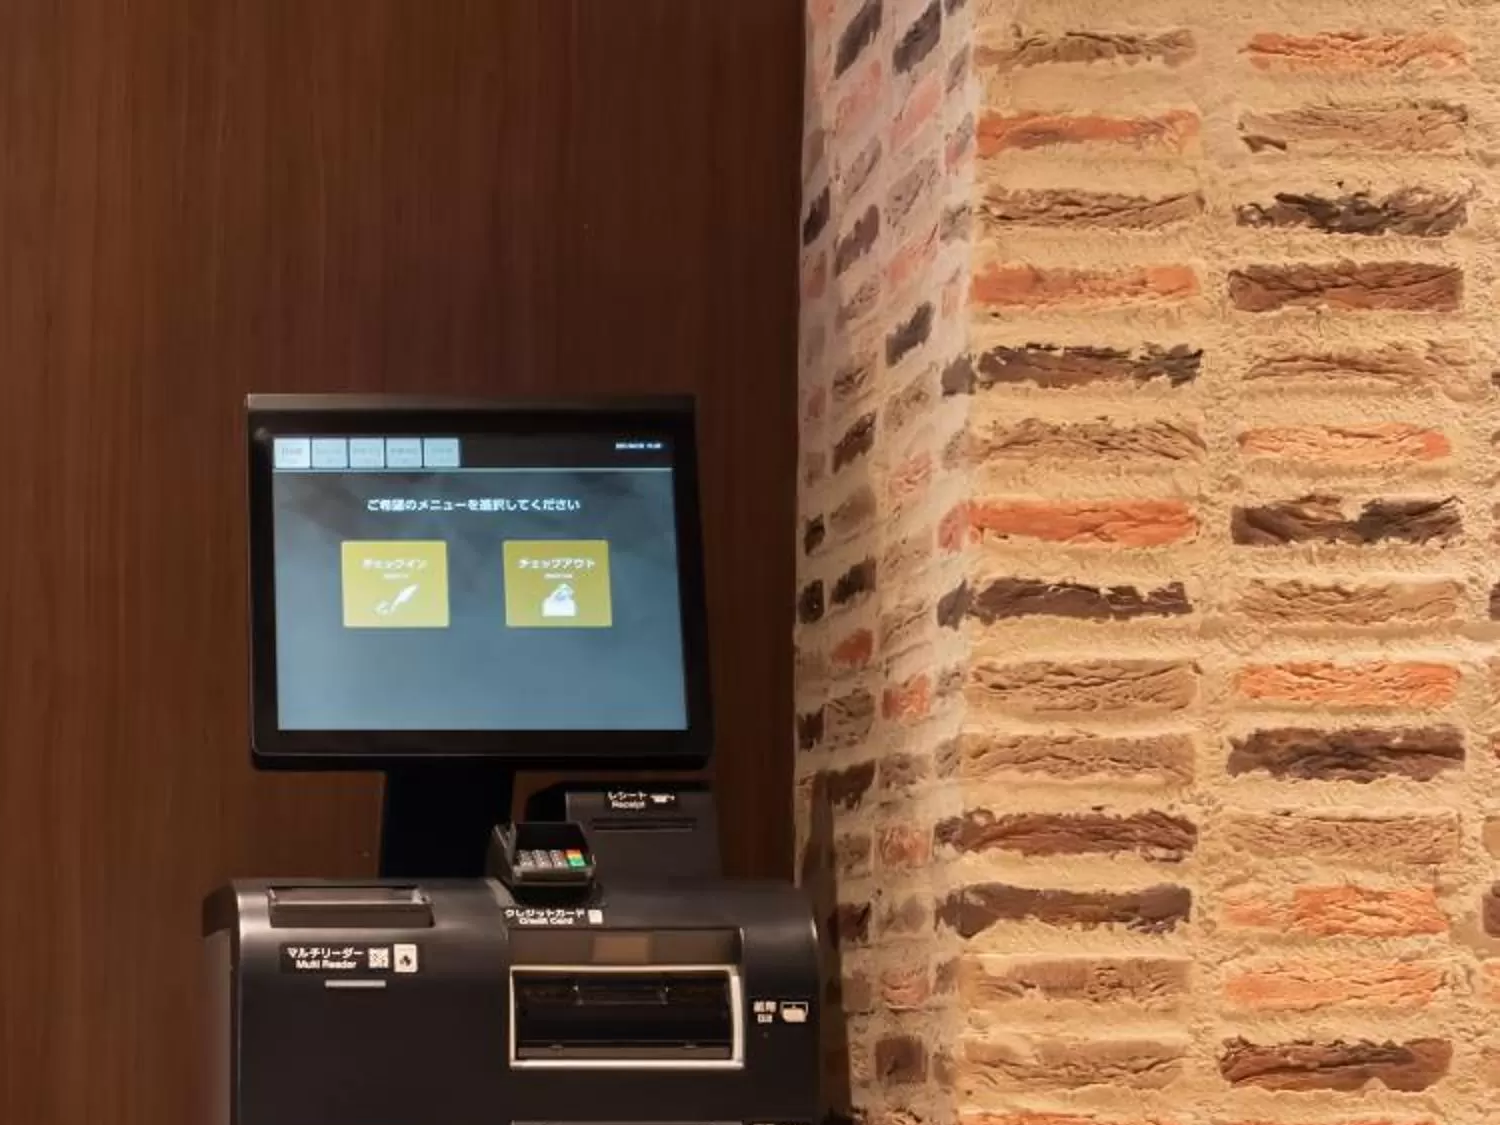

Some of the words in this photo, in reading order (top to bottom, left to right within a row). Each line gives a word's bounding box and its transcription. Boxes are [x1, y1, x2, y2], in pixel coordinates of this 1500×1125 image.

[286, 947, 364, 959] マルチリーダー
